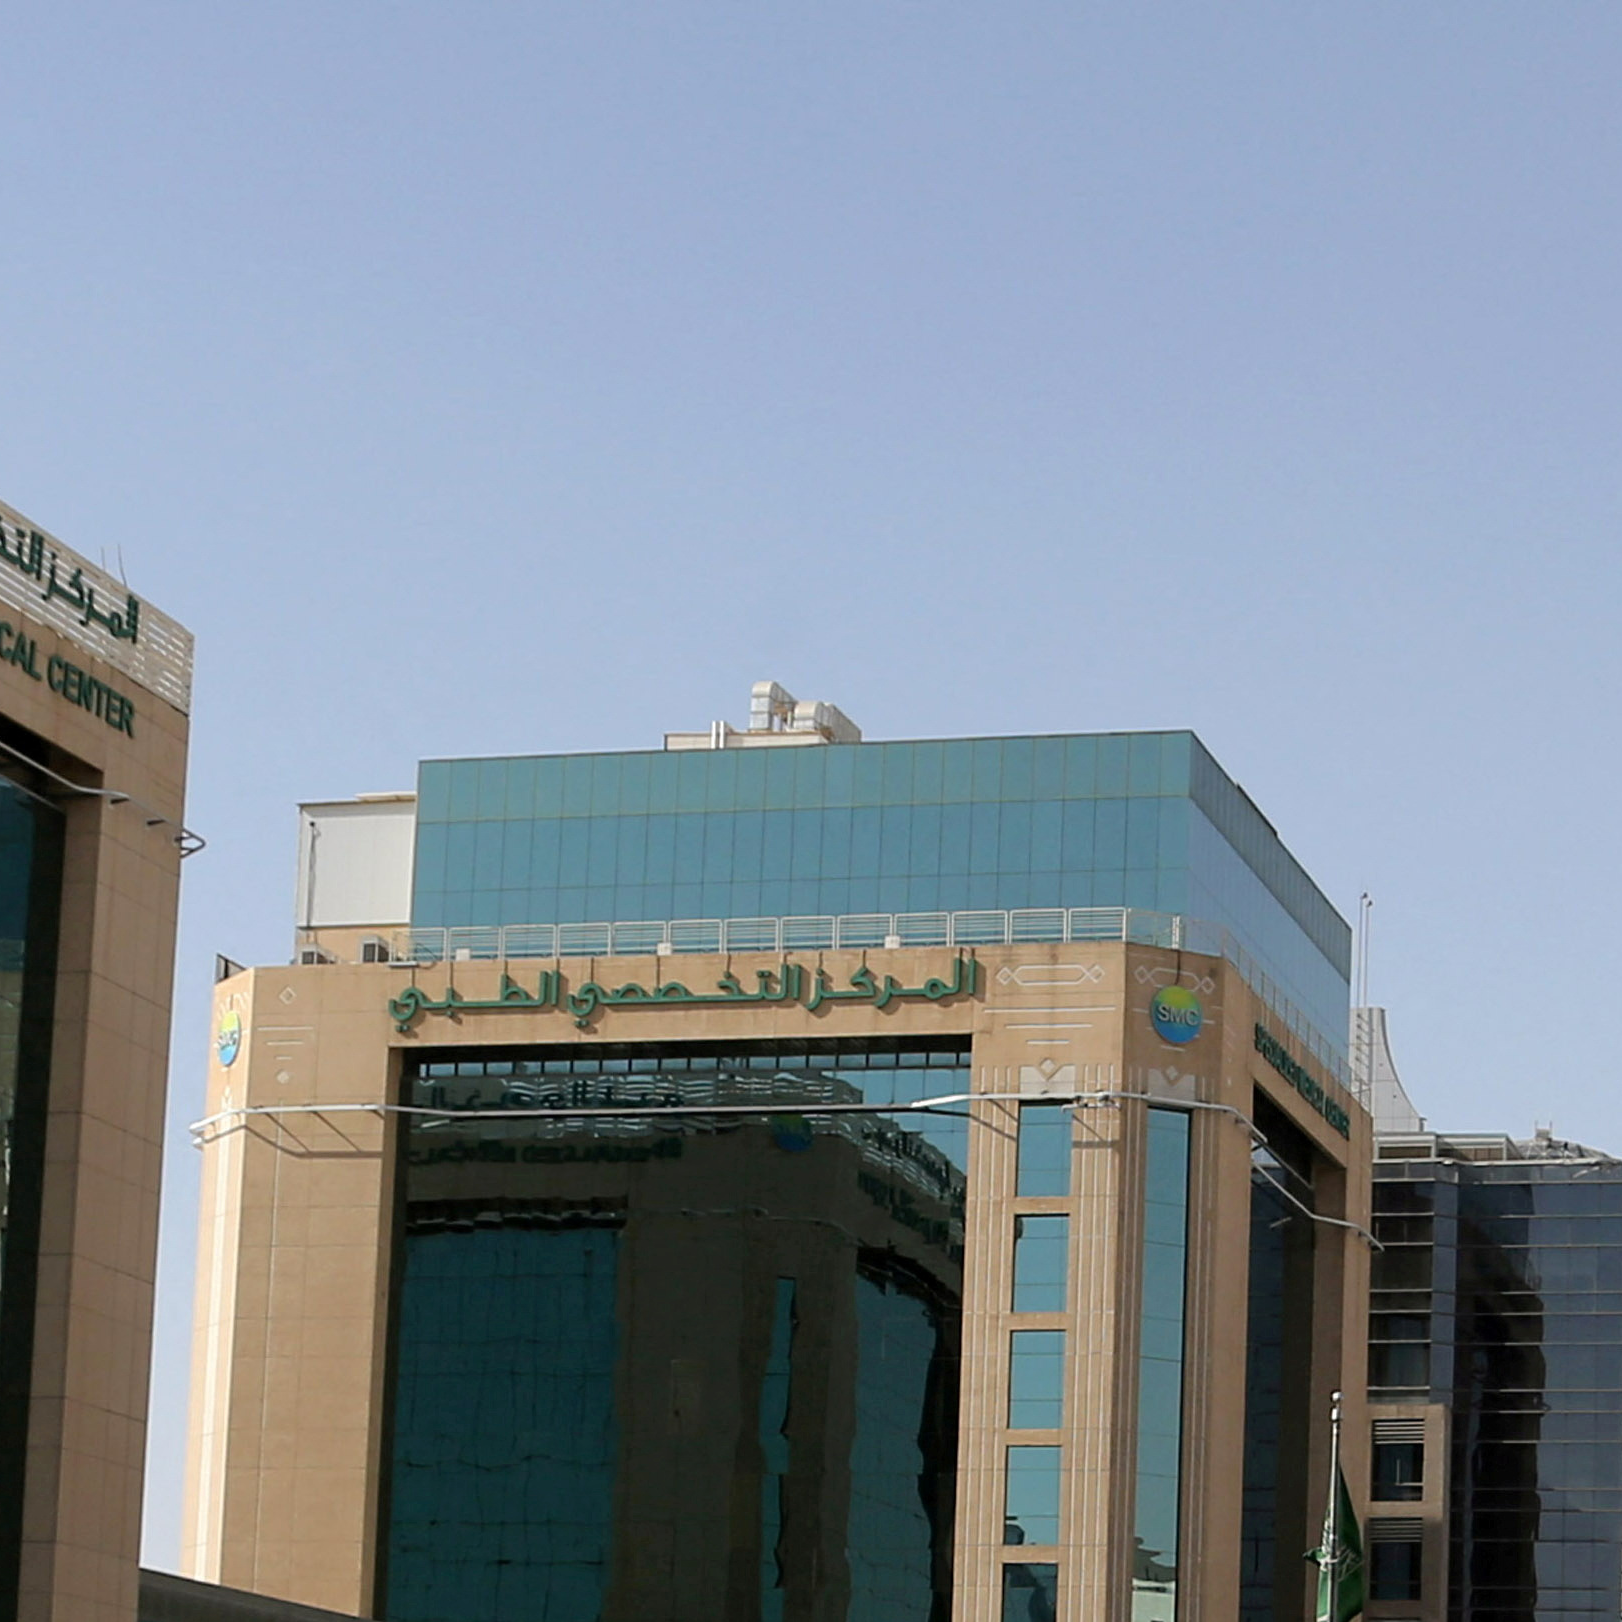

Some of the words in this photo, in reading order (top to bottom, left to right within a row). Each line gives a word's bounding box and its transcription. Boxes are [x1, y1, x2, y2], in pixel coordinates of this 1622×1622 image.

[41, 551, 139, 644] المركز
[47, 653, 136, 739] CENTER
[388, 969, 561, 1033] الطبي
[567, 964, 802, 1028] التخصصي
[806, 957, 976, 1011] المركز
[1157, 1003, 1200, 1026] SMC
